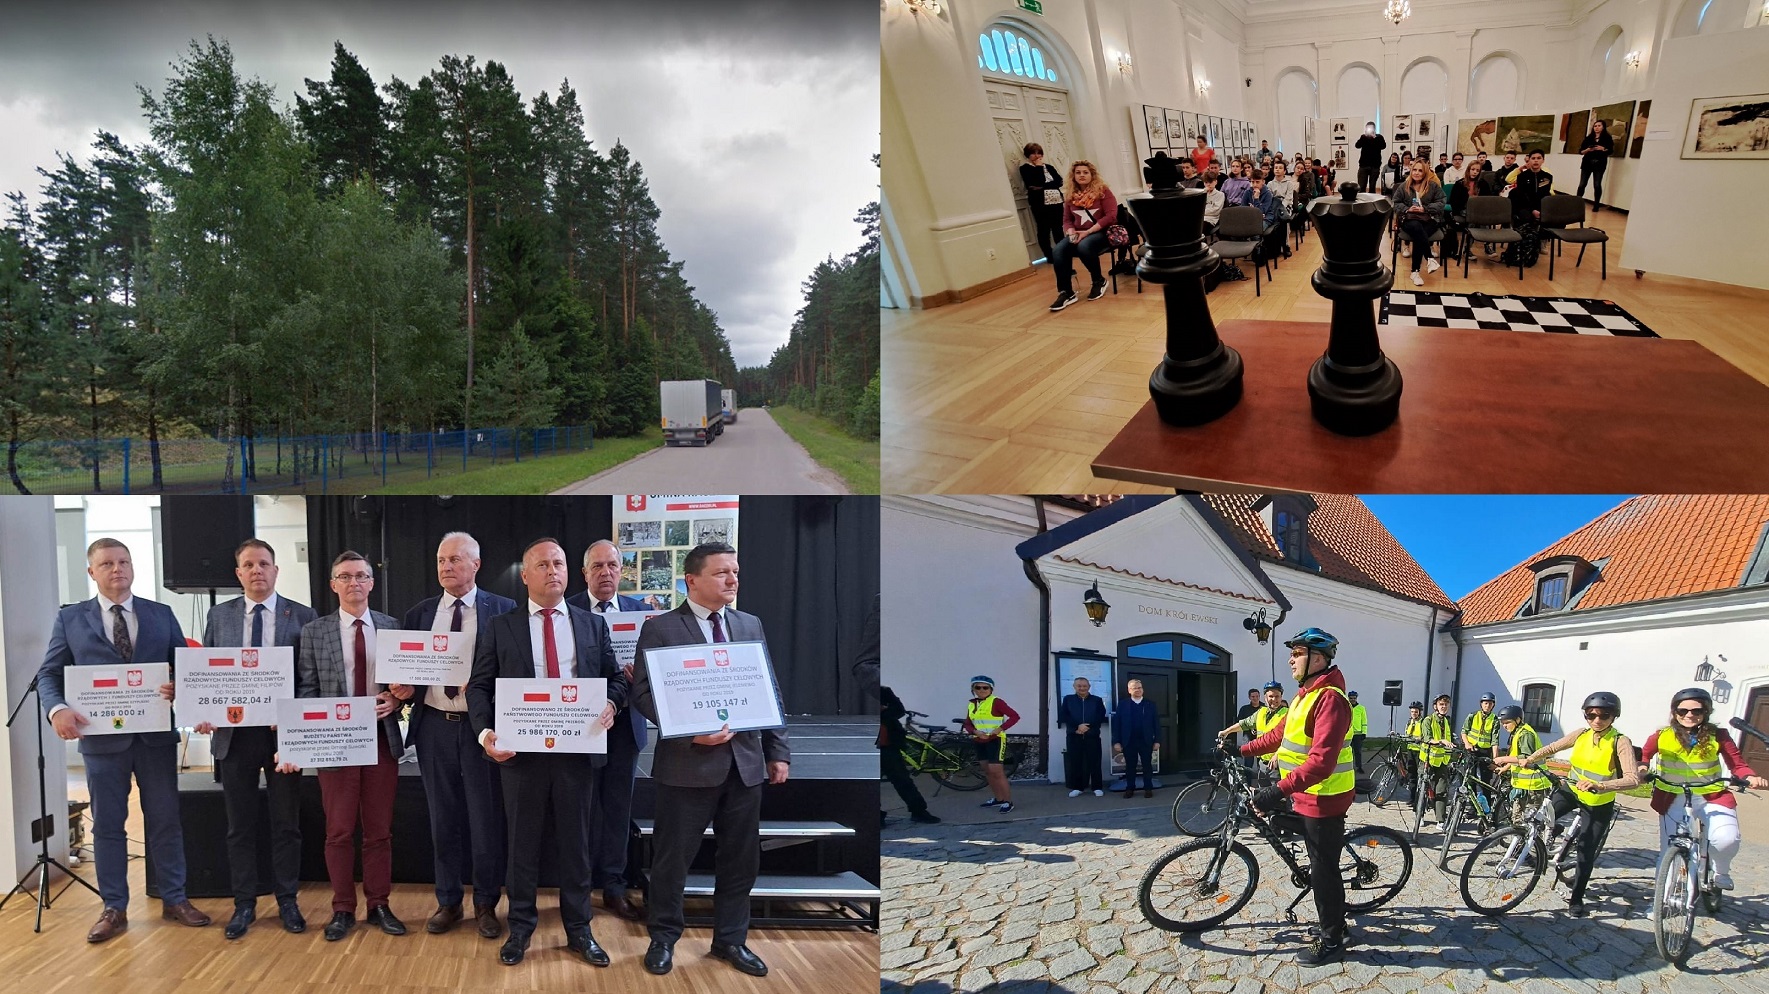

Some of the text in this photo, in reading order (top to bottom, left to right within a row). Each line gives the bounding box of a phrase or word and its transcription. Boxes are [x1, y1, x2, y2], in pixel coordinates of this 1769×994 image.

[1138, 604, 1218, 624] DOM KRÓLEWSKI
[231, 697, 261, 705] 582,04
[706, 700, 721, 708] 105
[724, 698, 738, 707] 147
[741, 697, 748, 706] zł
